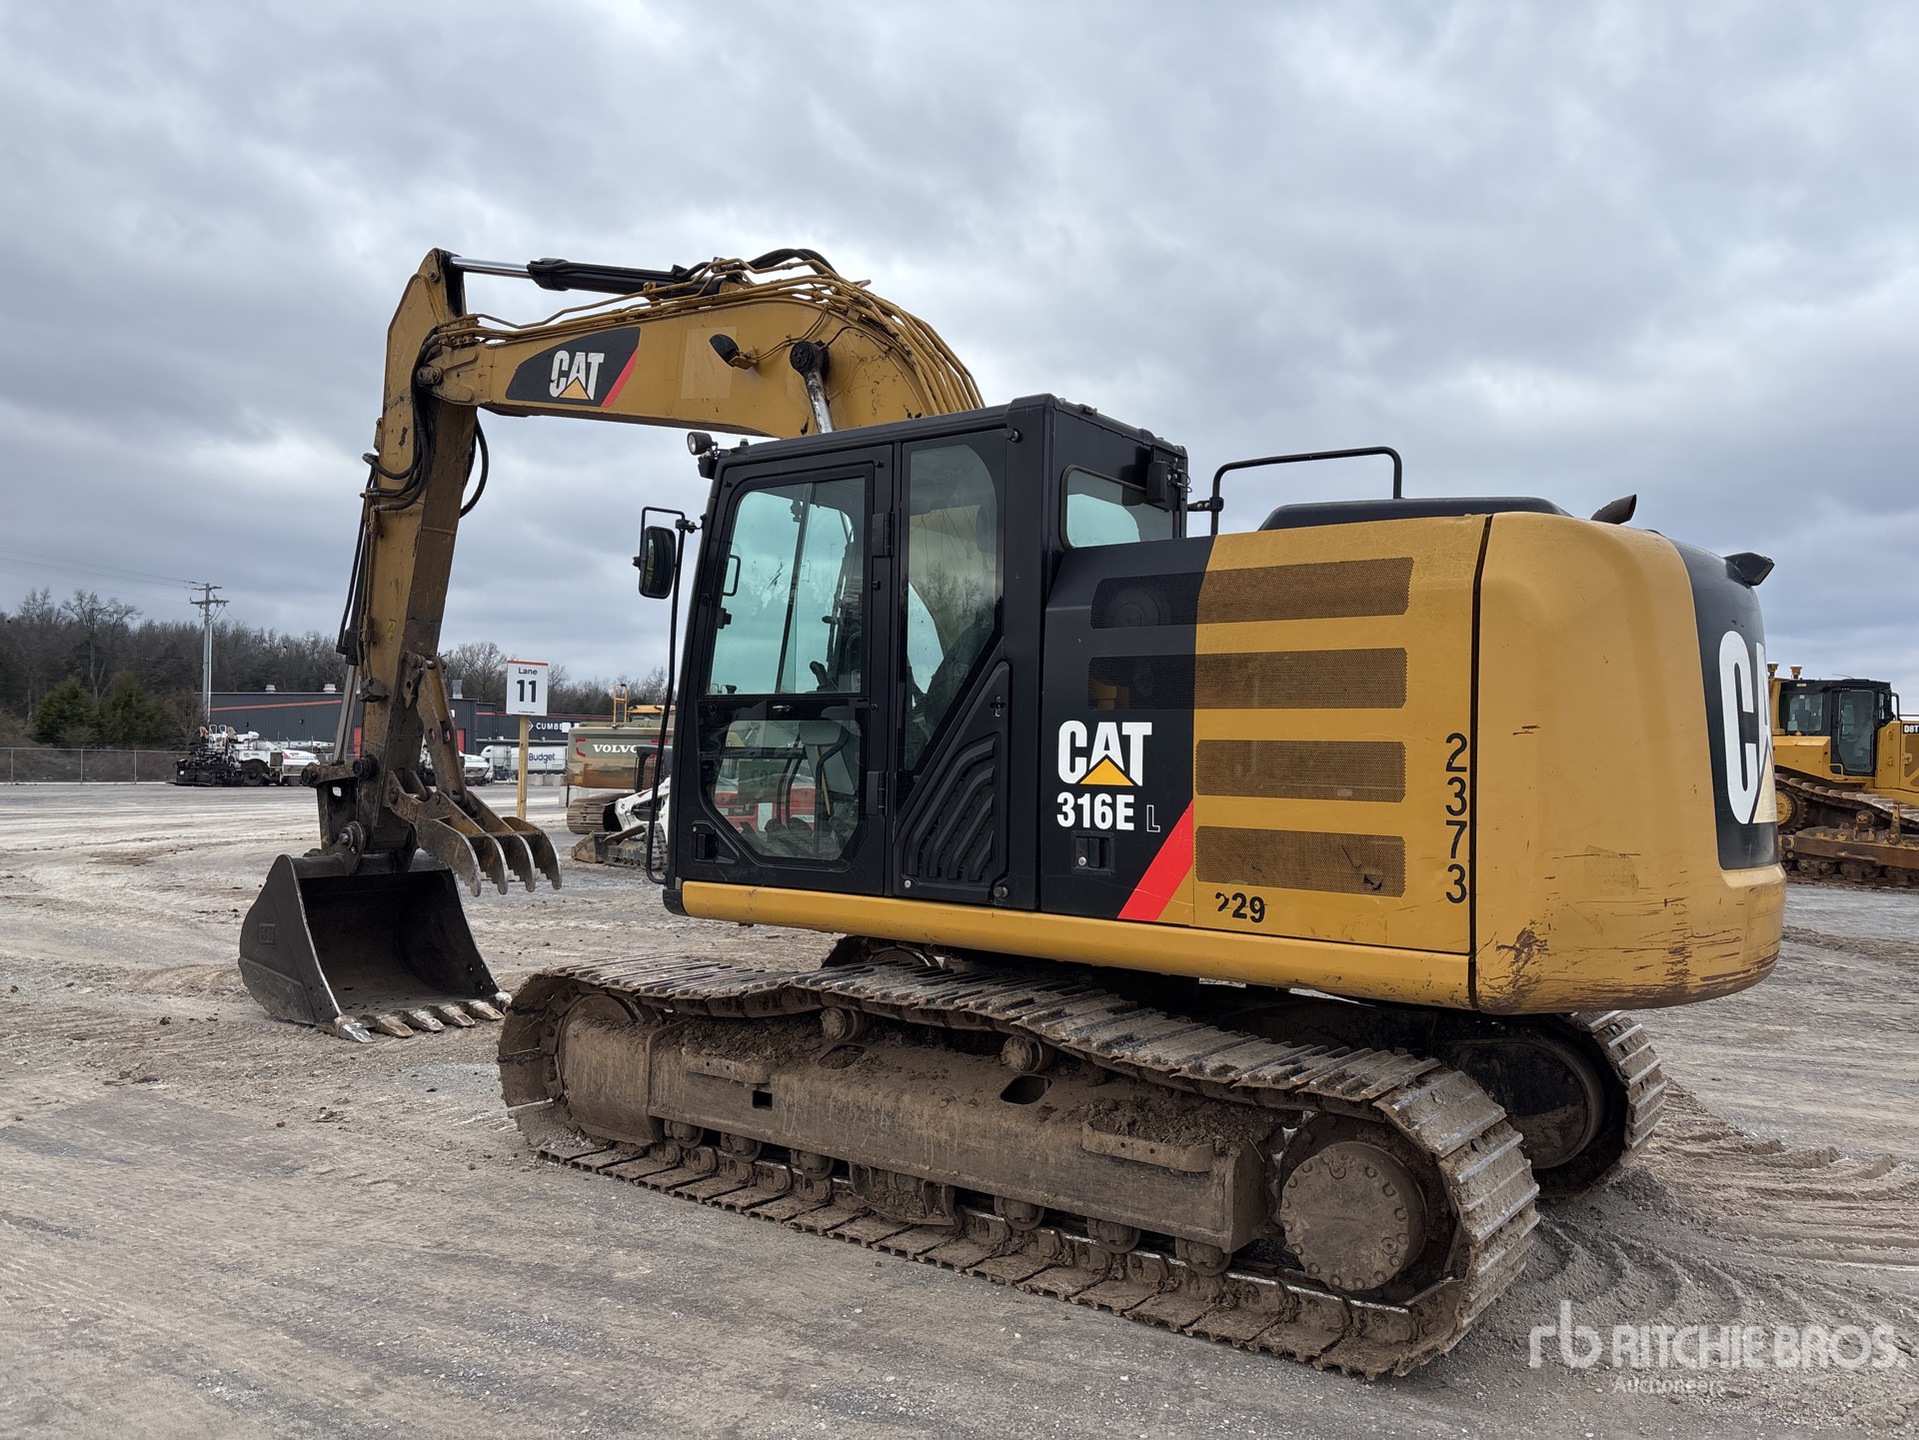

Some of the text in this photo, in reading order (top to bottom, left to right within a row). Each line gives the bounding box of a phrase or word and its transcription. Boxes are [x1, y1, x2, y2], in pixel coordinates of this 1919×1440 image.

[549, 350, 605, 400] CAT
[518, 667, 538, 675] Lane
[517, 679, 537, 703] 11
[529, 752, 555, 764] Budget
[1058, 720, 1152, 786] CAT
[1056, 791, 1161, 832] 316E L
